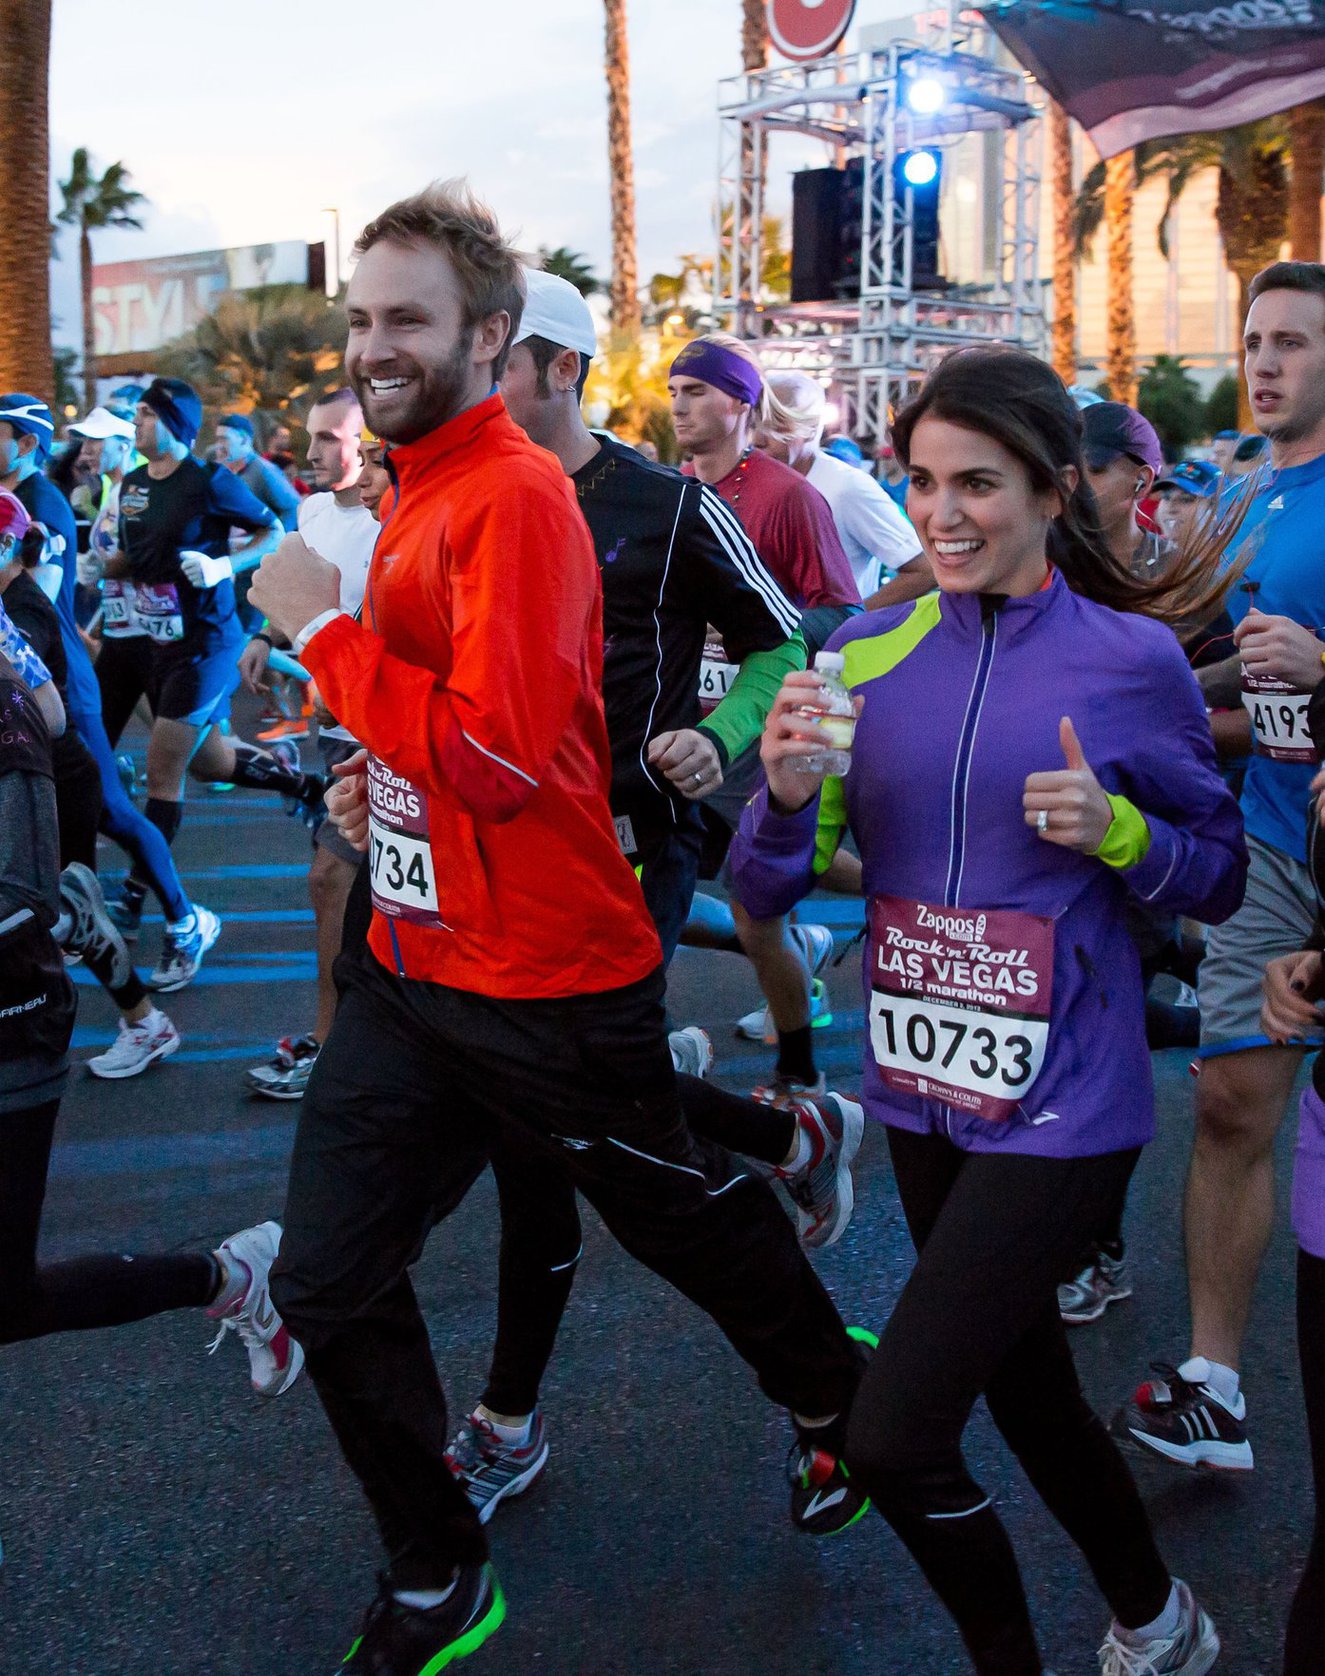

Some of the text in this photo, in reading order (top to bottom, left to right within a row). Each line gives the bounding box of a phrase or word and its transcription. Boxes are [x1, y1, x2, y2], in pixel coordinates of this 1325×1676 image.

[700, 668, 727, 693] 61
[916, 904, 975, 937] Zappos
[886, 925, 946, 957] Rock
[965, 943, 1028, 967] Roll
[877, 945, 1039, 996] LAS VEGAS
[900, 977, 1007, 1006] 1/2 marathon
[878, 1008, 1033, 1087] 10733
